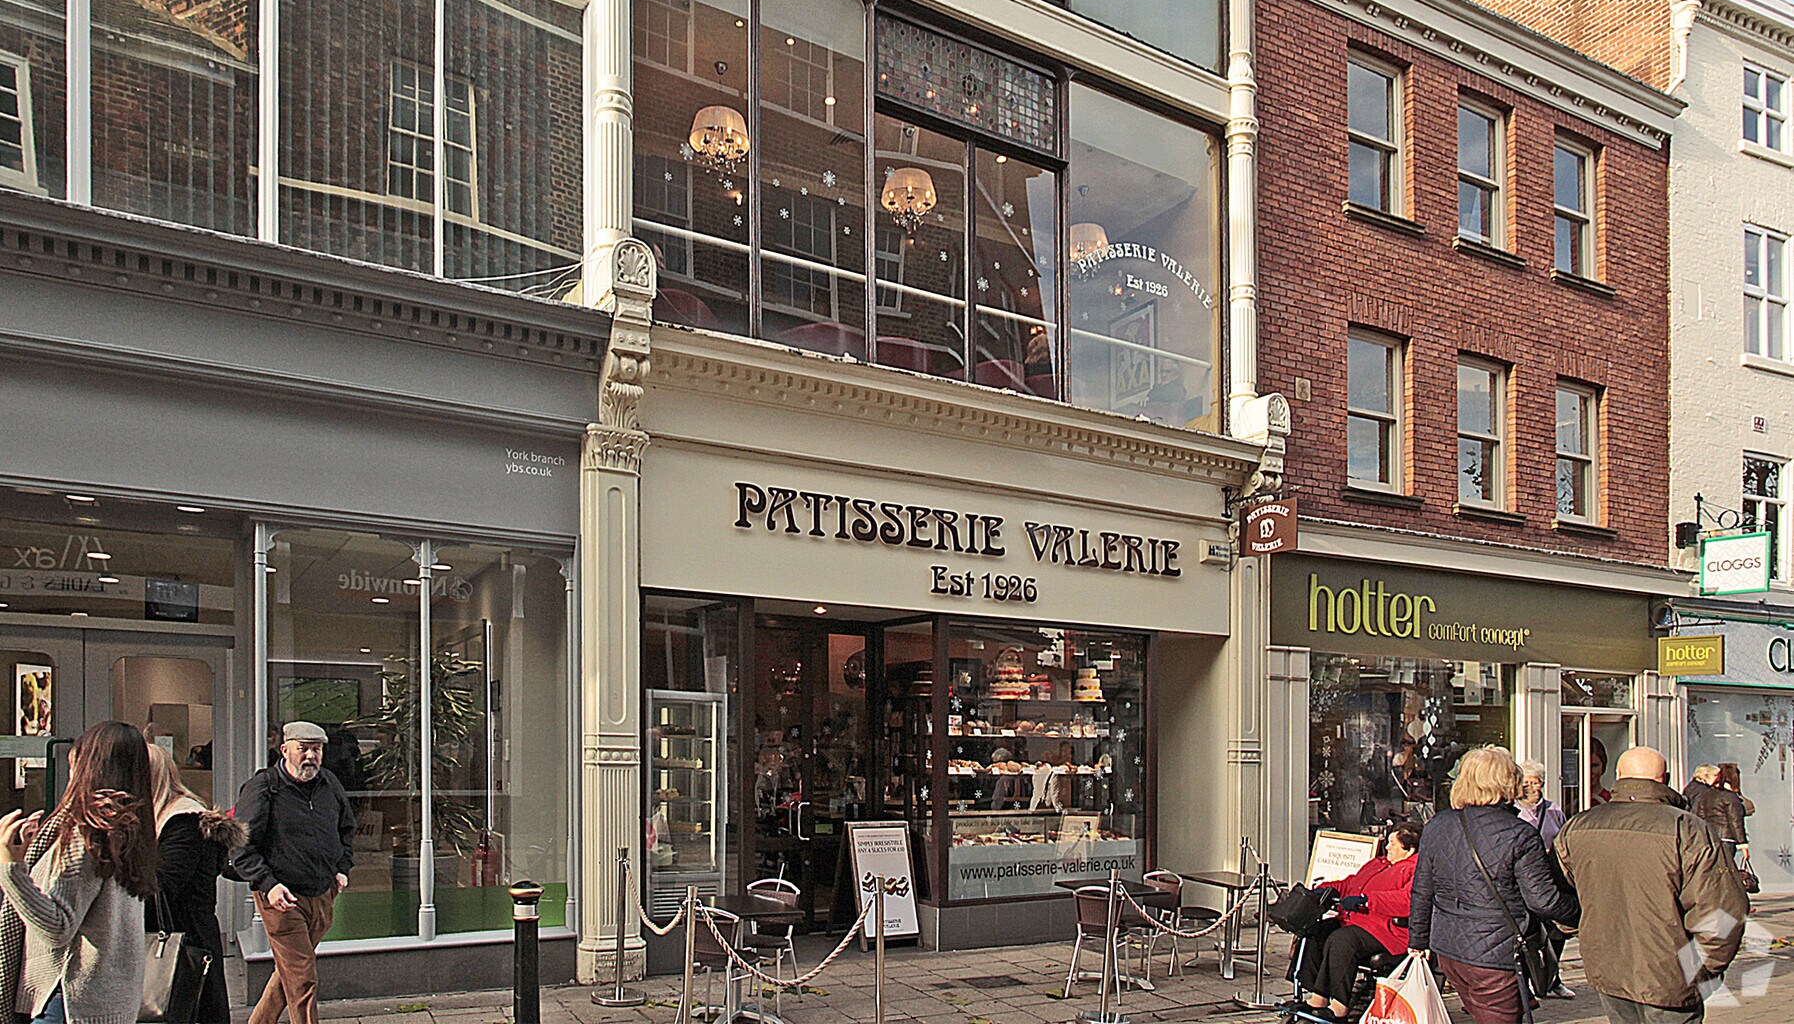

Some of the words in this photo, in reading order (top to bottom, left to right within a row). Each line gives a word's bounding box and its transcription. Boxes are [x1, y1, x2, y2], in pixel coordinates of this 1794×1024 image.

[1077, 243, 1156, 274] PATISSERIE
[1161, 252, 1213, 309] VALERIE
[1126, 274, 1143, 291] Est
[1145, 280, 1169, 298] 1926
[505, 448, 529, 462] York
[531, 451, 565, 466] branch
[505, 462, 552, 477] ybs.co.uk
[734, 481, 1006, 557] PATISSERIE
[1024, 521, 1182, 578] VALERIE
[1707, 556, 1762, 573] CLOGGS
[930, 565, 975, 597] Est
[981, 572, 1038, 603] 1926
[1309, 573, 1437, 639] hotter
[1428, 621, 1477, 643] comfort
[1666, 644, 1716, 661] hotter
[960, 855, 1136, 881] www.patisserie-valerie.co.uk
